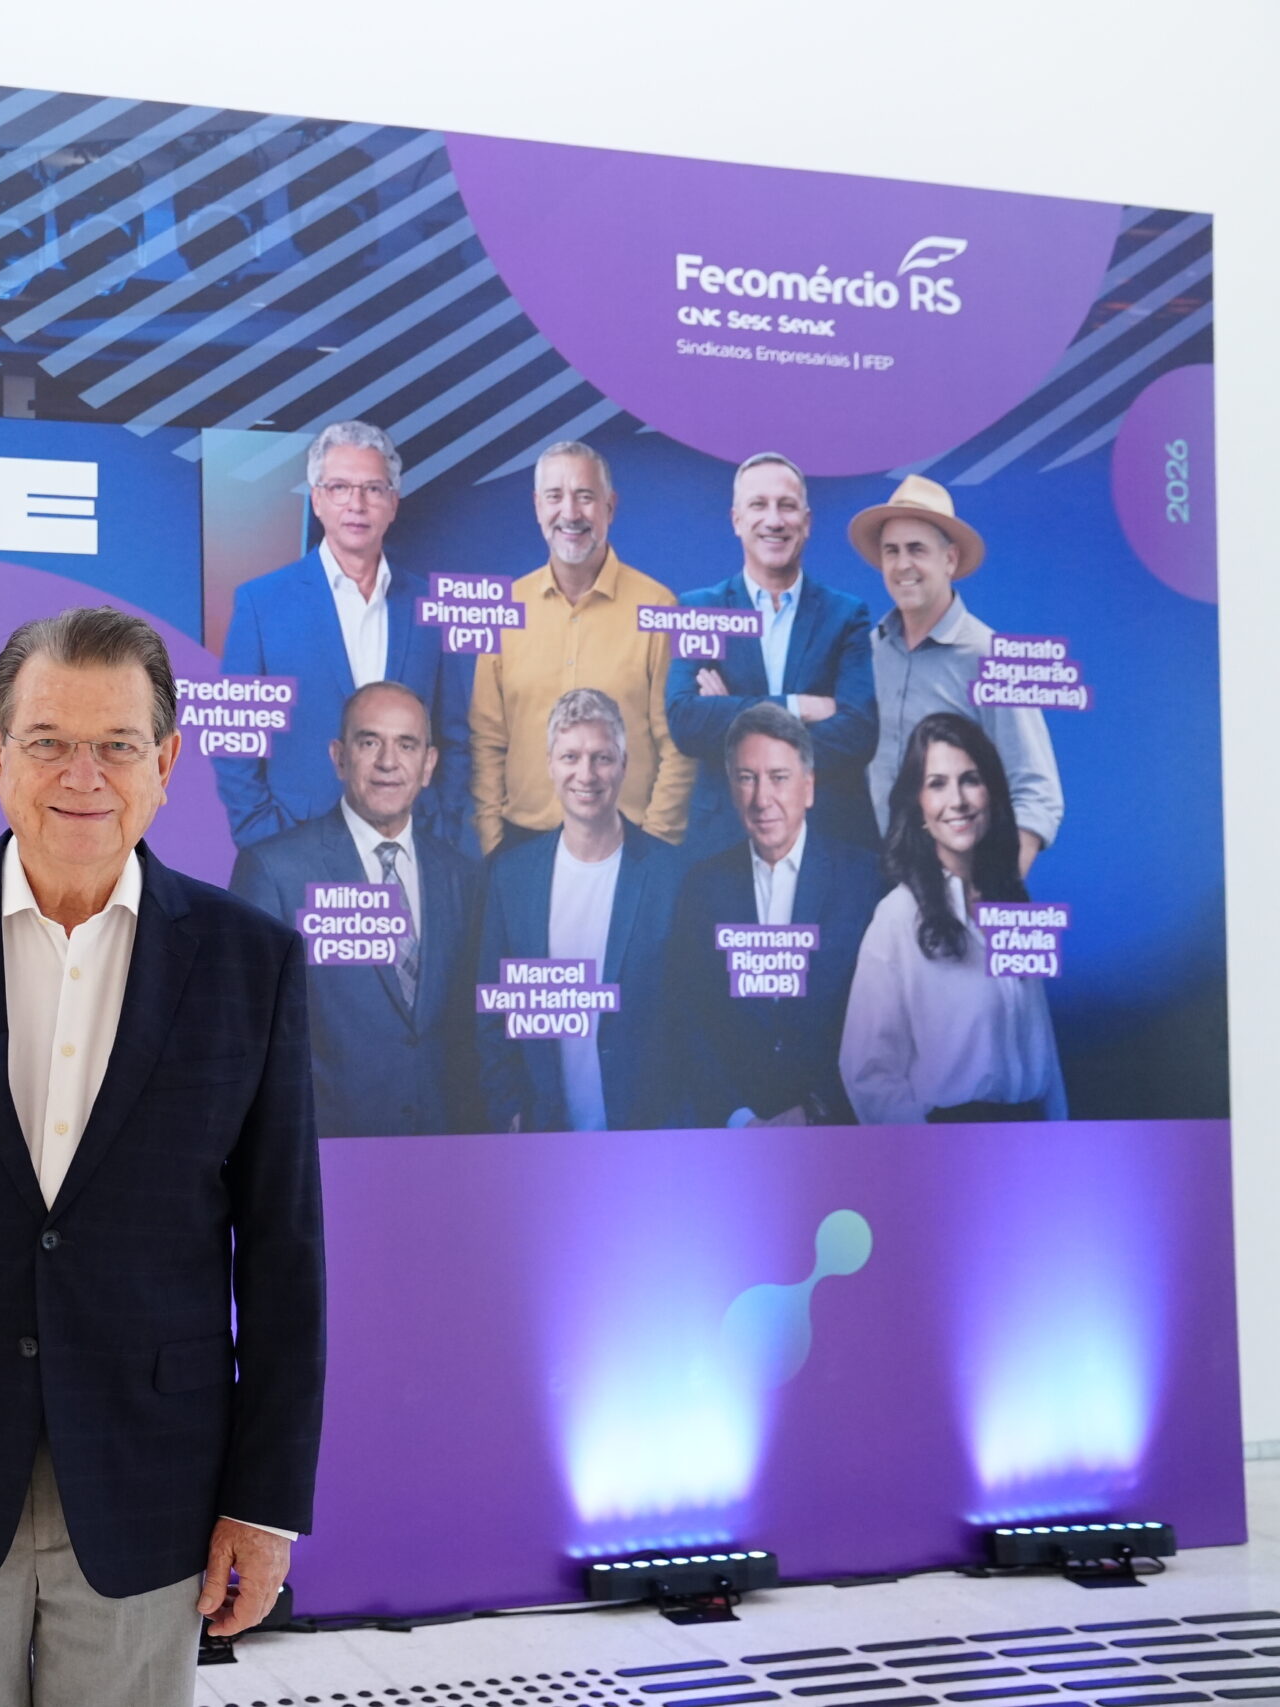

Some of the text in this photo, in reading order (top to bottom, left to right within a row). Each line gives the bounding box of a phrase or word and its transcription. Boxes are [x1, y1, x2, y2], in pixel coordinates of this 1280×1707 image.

[676, 253, 962, 315] Fecomércio RS
[677, 306, 836, 337] CNC Sesc Senac
[676, 338, 753, 361] Sindicatos
[755, 345, 851, 369] Empresariais
[862, 355, 895, 371] IFEP
[1164, 439, 1190, 524] 2026
[437, 578, 504, 600] Paulo
[422, 601, 519, 626] Pimenta
[638, 608, 758, 633] Sanderson
[448, 626, 494, 652] (PT)
[678, 633, 720, 659] (PL)
[993, 637, 1066, 660] Renato
[981, 660, 1078, 685] Jaguarão
[175, 678, 292, 702] Frederico
[973, 681, 1088, 710] (Cidadania)
[180, 704, 286, 728] Antunes
[199, 729, 267, 757] (PSD)
[314, 886, 390, 909] Milton
[303, 912, 406, 934] Cardoso
[979, 906, 1068, 927] Manuela
[313, 937, 396, 964] (PSDB)
[718, 928, 815, 948] Germano
[506, 962, 585, 984] Marcel
[731, 950, 806, 974] Rigotto
[990, 951, 1058, 977] (PSOL)
[738, 972, 800, 997] (MDB)
[480, 988, 615, 1009] Van Hattem
[507, 1011, 590, 1039] (NOVO)
